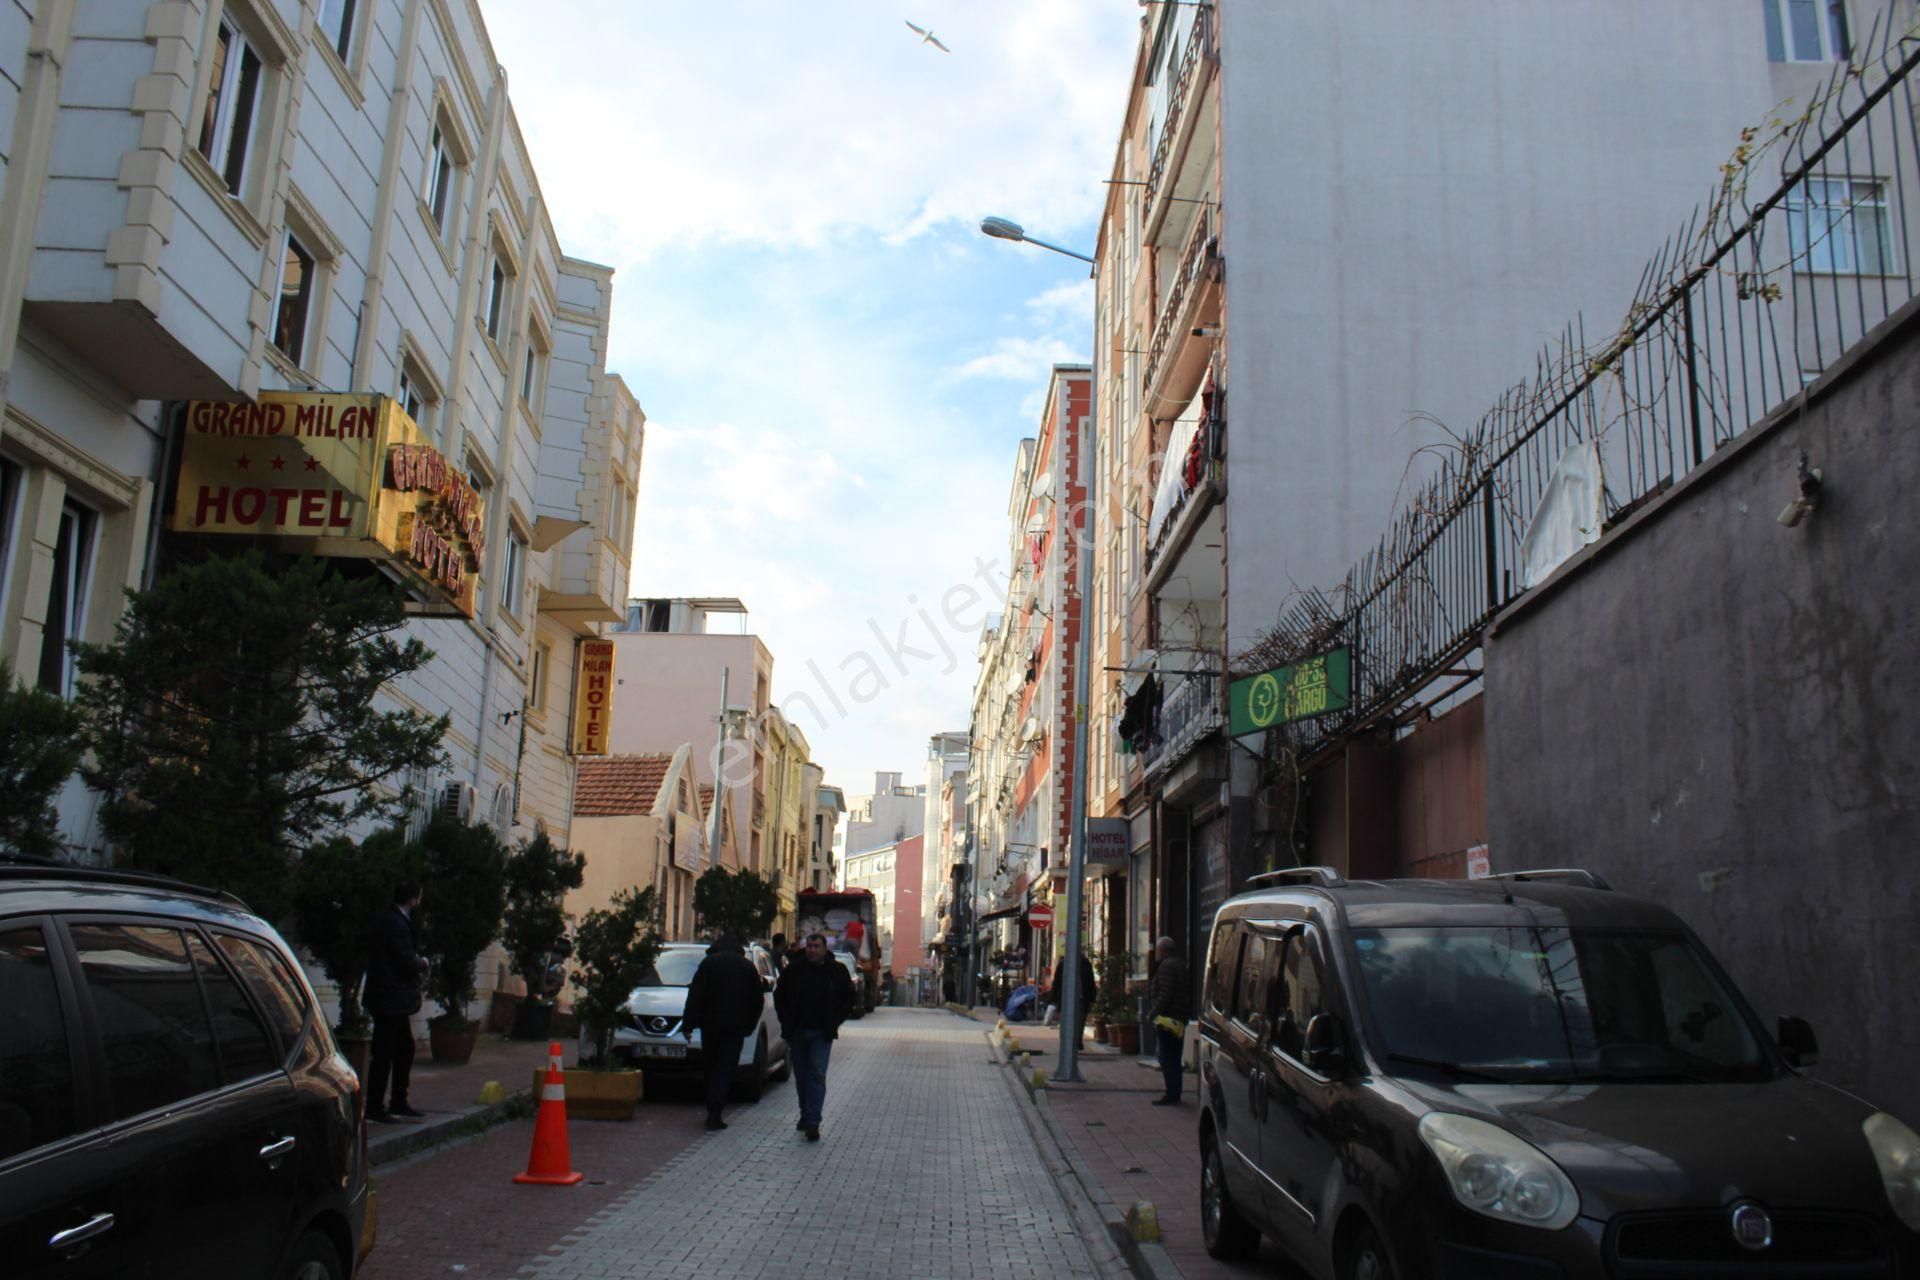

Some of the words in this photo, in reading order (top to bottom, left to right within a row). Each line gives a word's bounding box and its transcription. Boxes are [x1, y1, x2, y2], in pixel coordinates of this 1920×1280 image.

[193, 401, 286, 437] GRAND
[195, 485, 353, 528] HOTEL
[584, 643, 613, 656] GRAND
[586, 674, 605, 752] HOTEL
[1091, 832, 1126, 844] HOTEL
